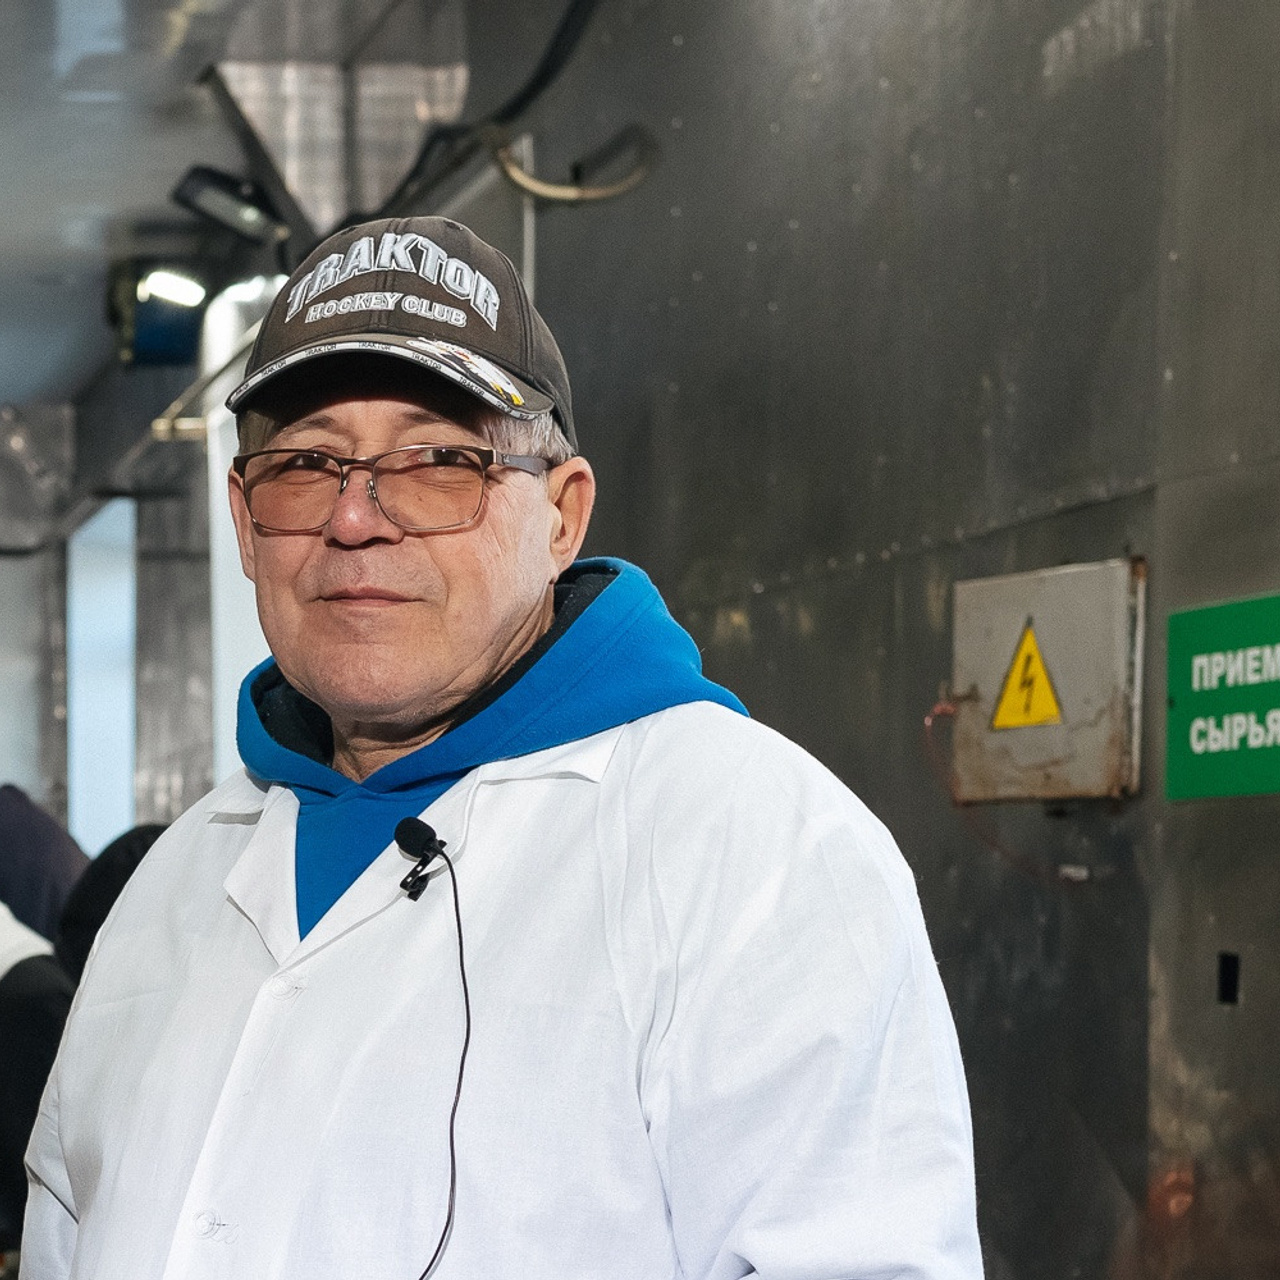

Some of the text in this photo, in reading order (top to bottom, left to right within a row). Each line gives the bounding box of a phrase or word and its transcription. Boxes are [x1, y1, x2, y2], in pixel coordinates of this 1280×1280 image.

[285, 232, 500, 331] TRAKTOR
[305, 292, 468, 328] HOCKEY CLUB
